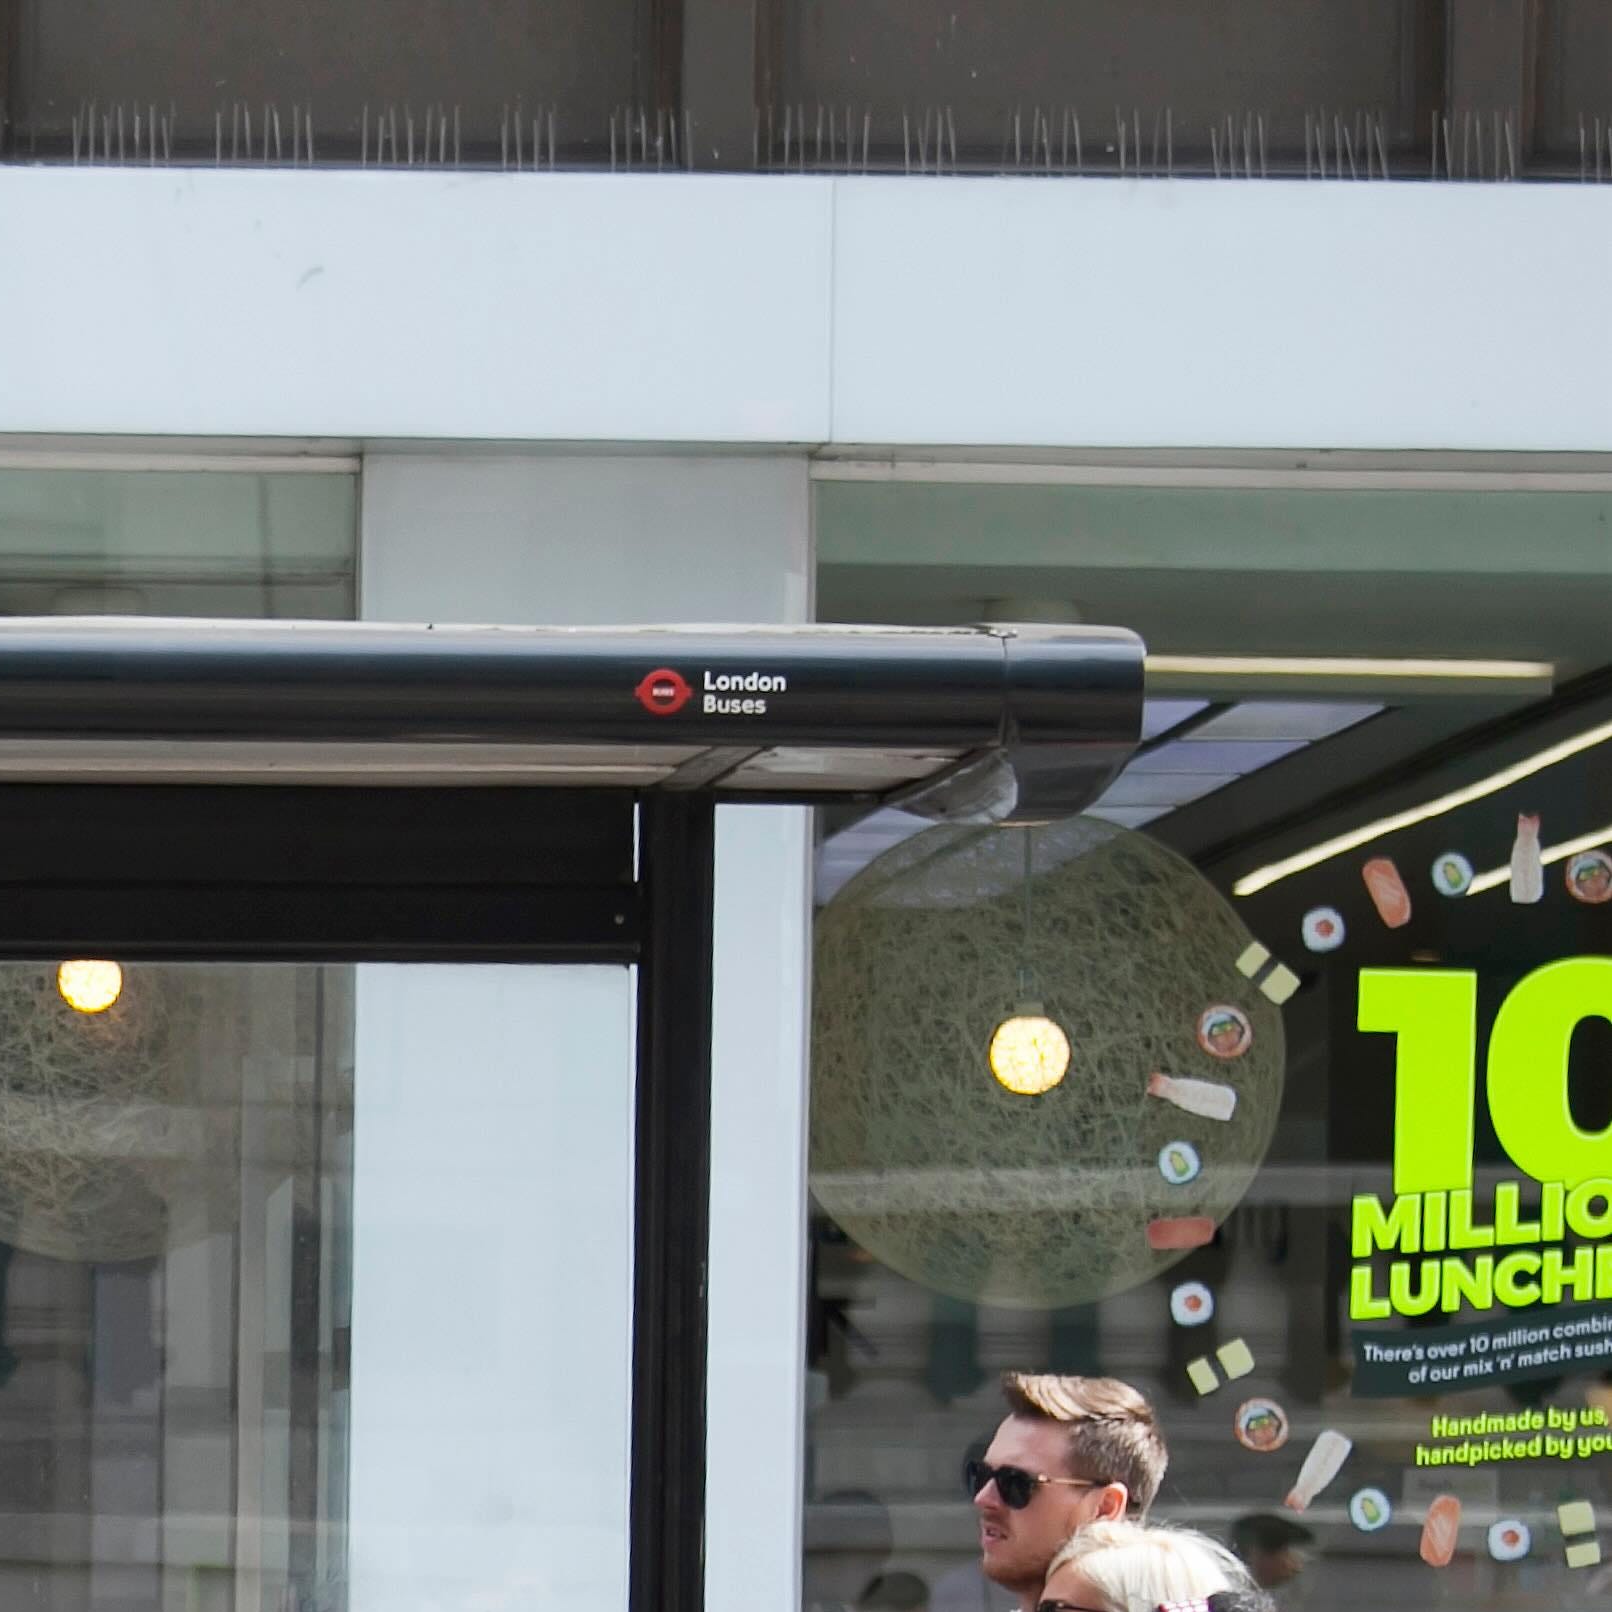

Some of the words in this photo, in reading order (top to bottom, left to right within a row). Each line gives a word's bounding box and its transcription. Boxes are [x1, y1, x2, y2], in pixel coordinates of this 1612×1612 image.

[703, 671, 787, 692] London
[703, 694, 767, 714] Buses
[1357, 955, 1612, 1194] 10
[1351, 1177, 1612, 1258] MILLIO
[1363, 1342, 1425, 1362] There's
[1427, 1342, 1467, 1360] over
[1469, 1334, 1489, 1352] 10
[1492, 1328, 1550, 1350] million
[1408, 1368, 1427, 1384] of
[1429, 1366, 1461, 1383] our
[1463, 1359, 1494, 1377] mix
[1517, 1343, 1572, 1368] match
[1431, 1408, 1545, 1439] Handmade
[1547, 1405, 1577, 1433] by
[1579, 1405, 1609, 1428] us,
[1415, 1434, 1543, 1467] handpicked
[1544, 1434, 1575, 1460] by
